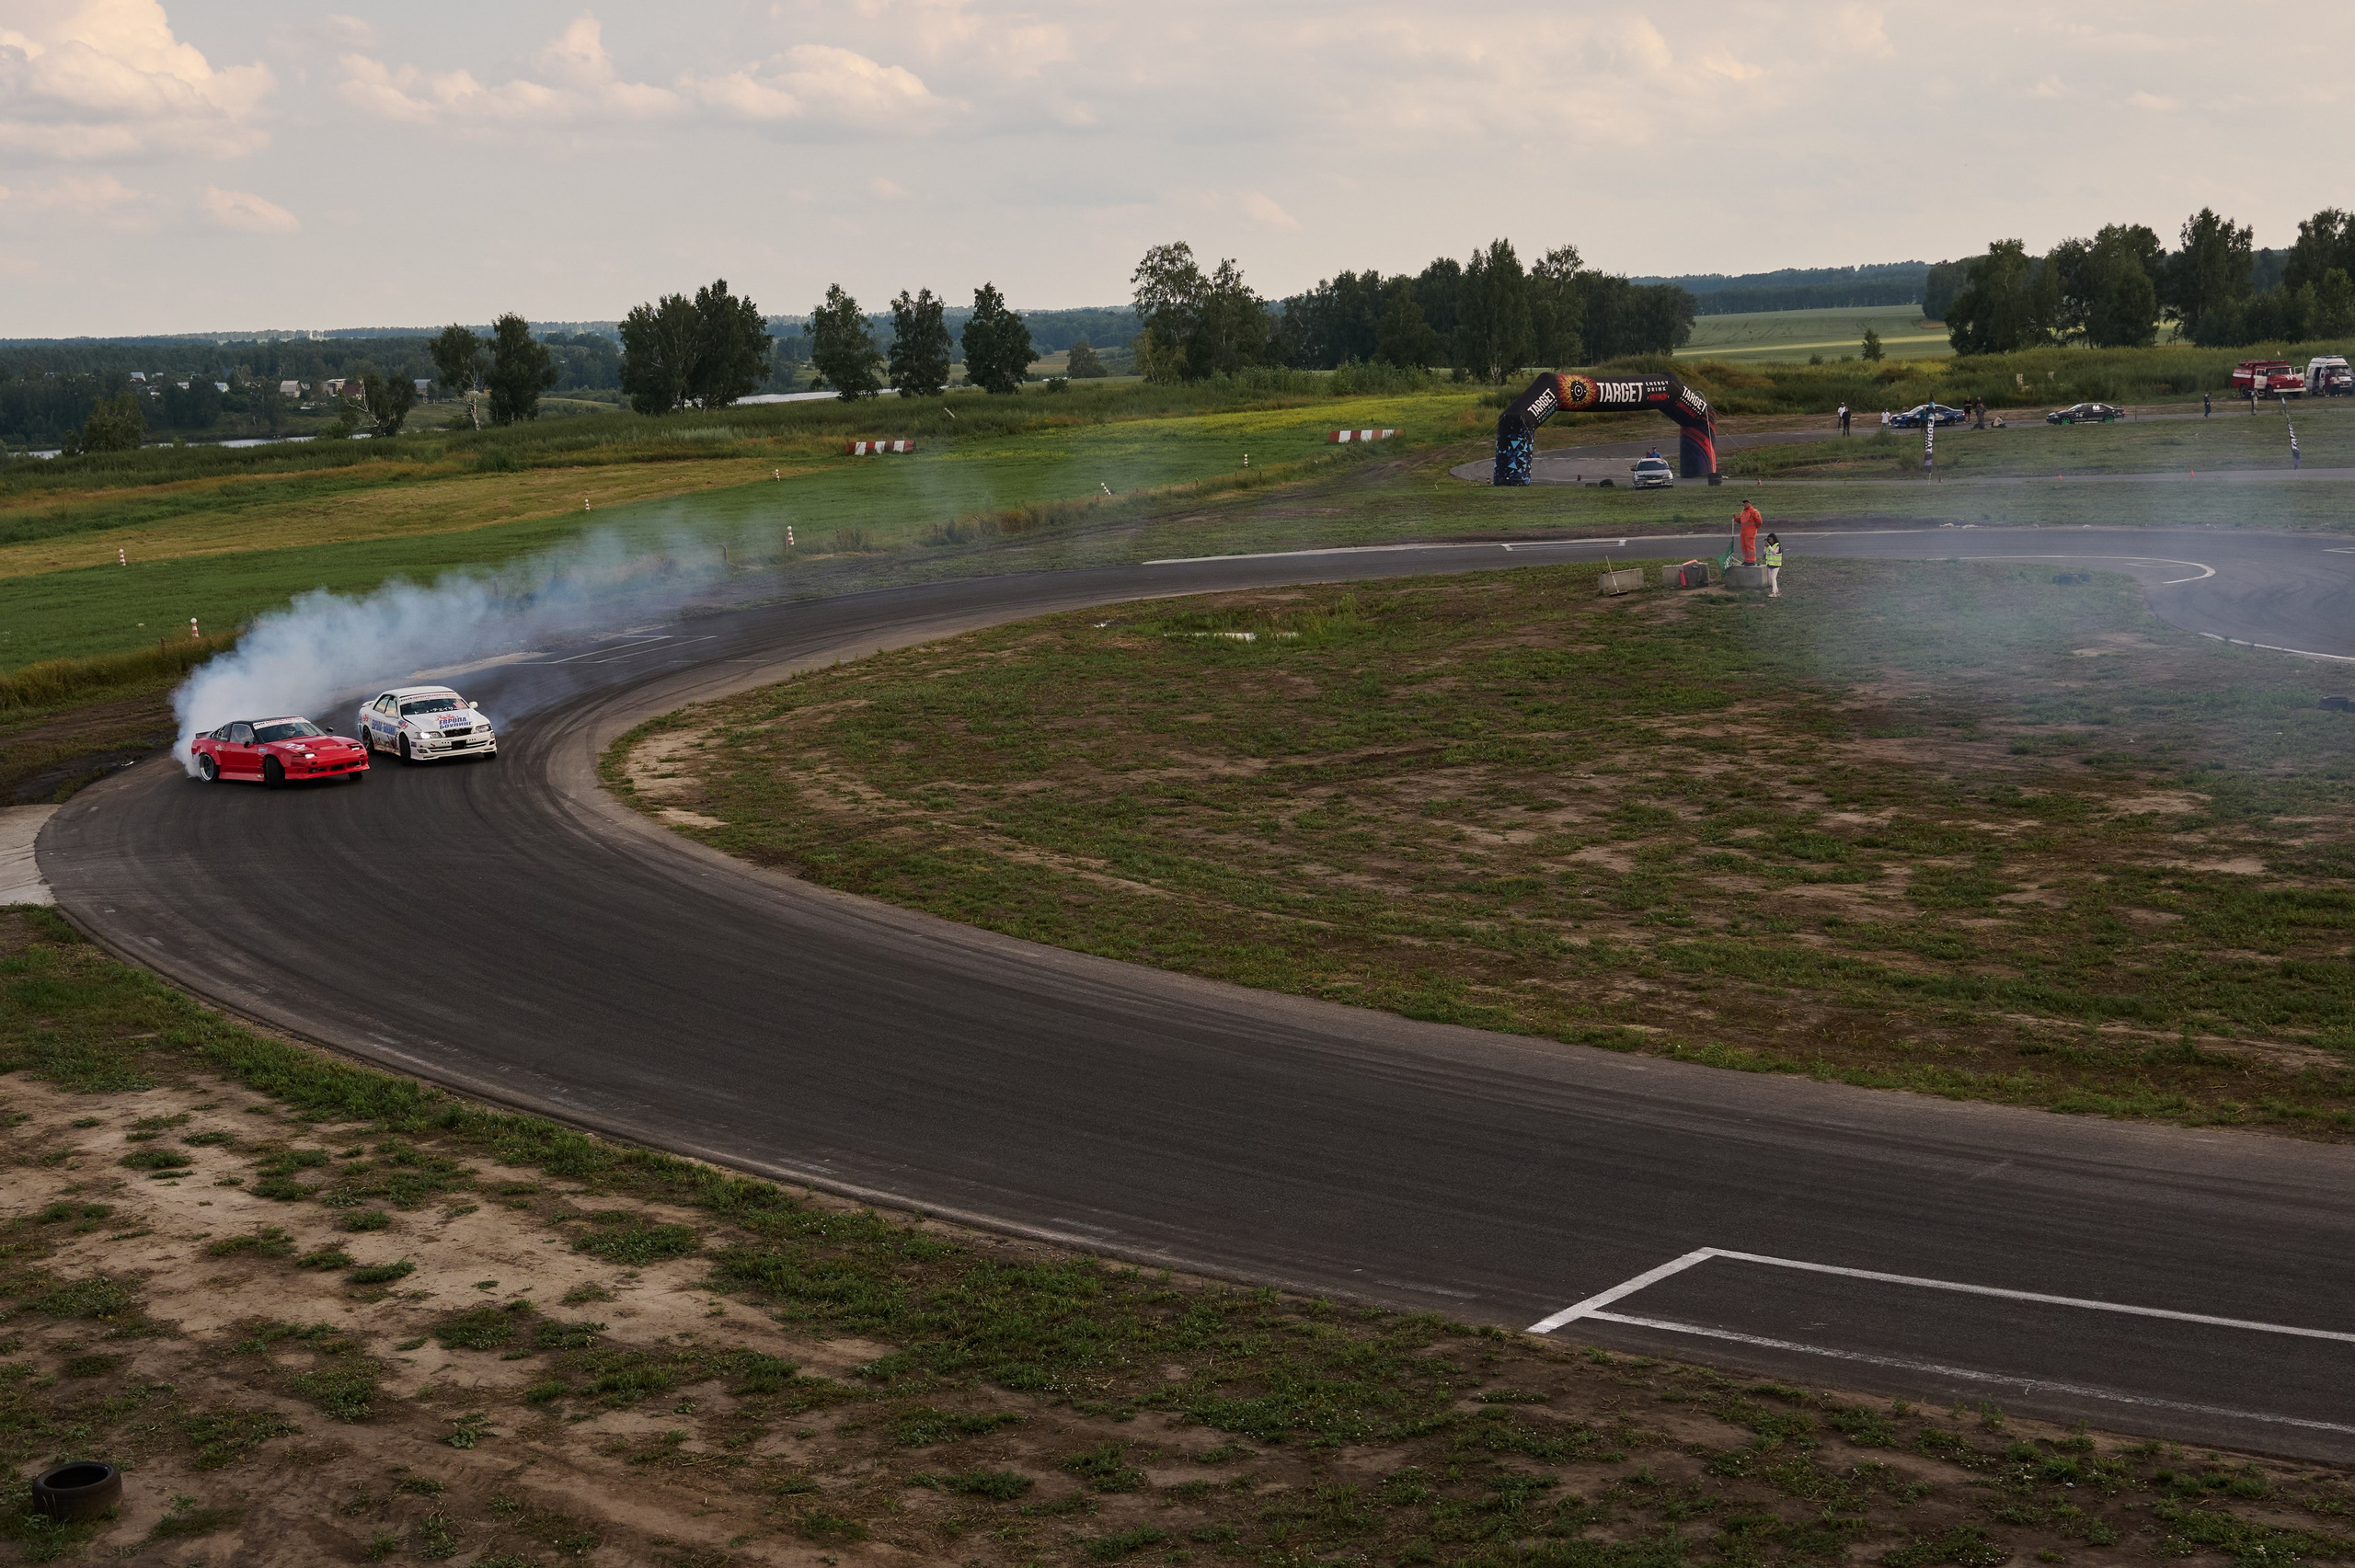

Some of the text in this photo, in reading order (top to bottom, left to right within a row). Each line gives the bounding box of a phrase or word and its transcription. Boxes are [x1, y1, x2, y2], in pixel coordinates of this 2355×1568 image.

[1527, 387, 1556, 418] TARGET
[1596, 382, 1644, 403] TARGET
[1683, 385, 1707, 413] TARGET
[439, 716, 467, 726] ЕВРОПА
